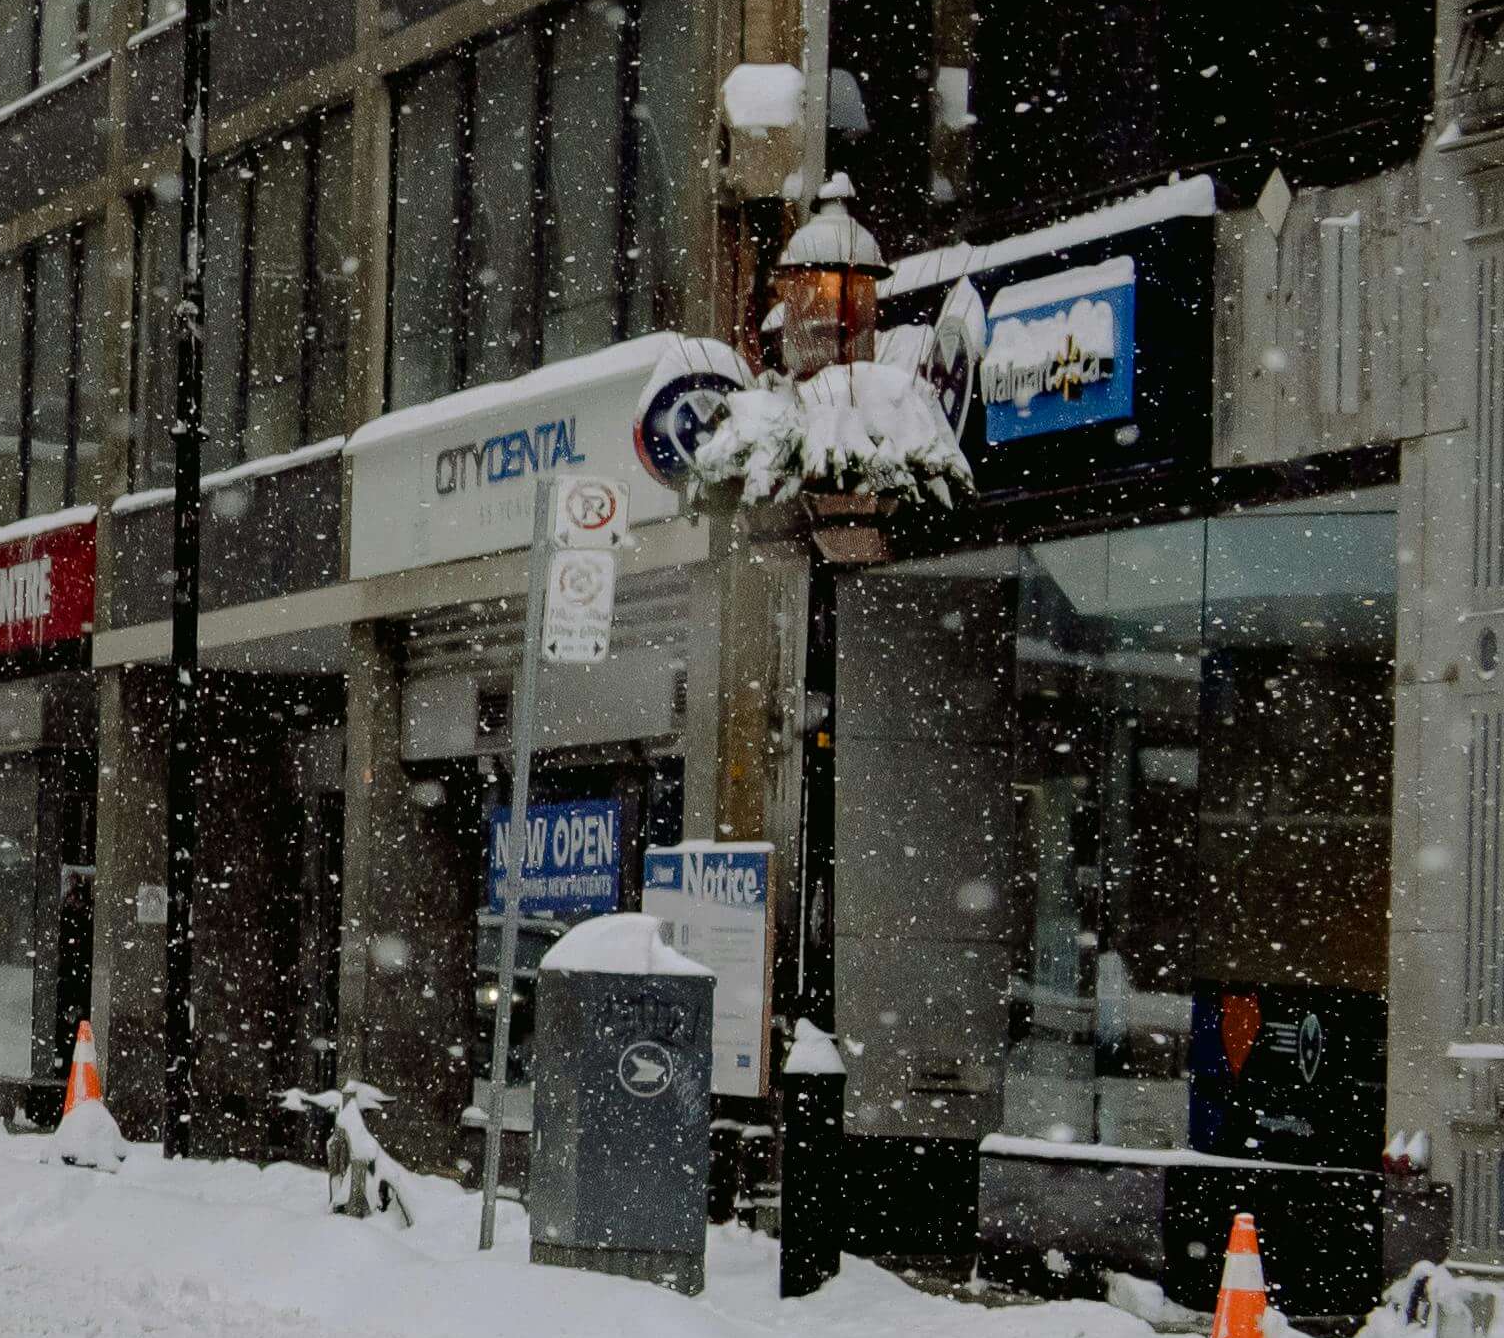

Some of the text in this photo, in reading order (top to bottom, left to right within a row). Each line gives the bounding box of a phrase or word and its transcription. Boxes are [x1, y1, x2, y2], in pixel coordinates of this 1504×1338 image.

[979, 353, 1057, 406] Walmart
[496, 810, 614, 870] NW OPEN
[683, 852, 758, 903] Notice
